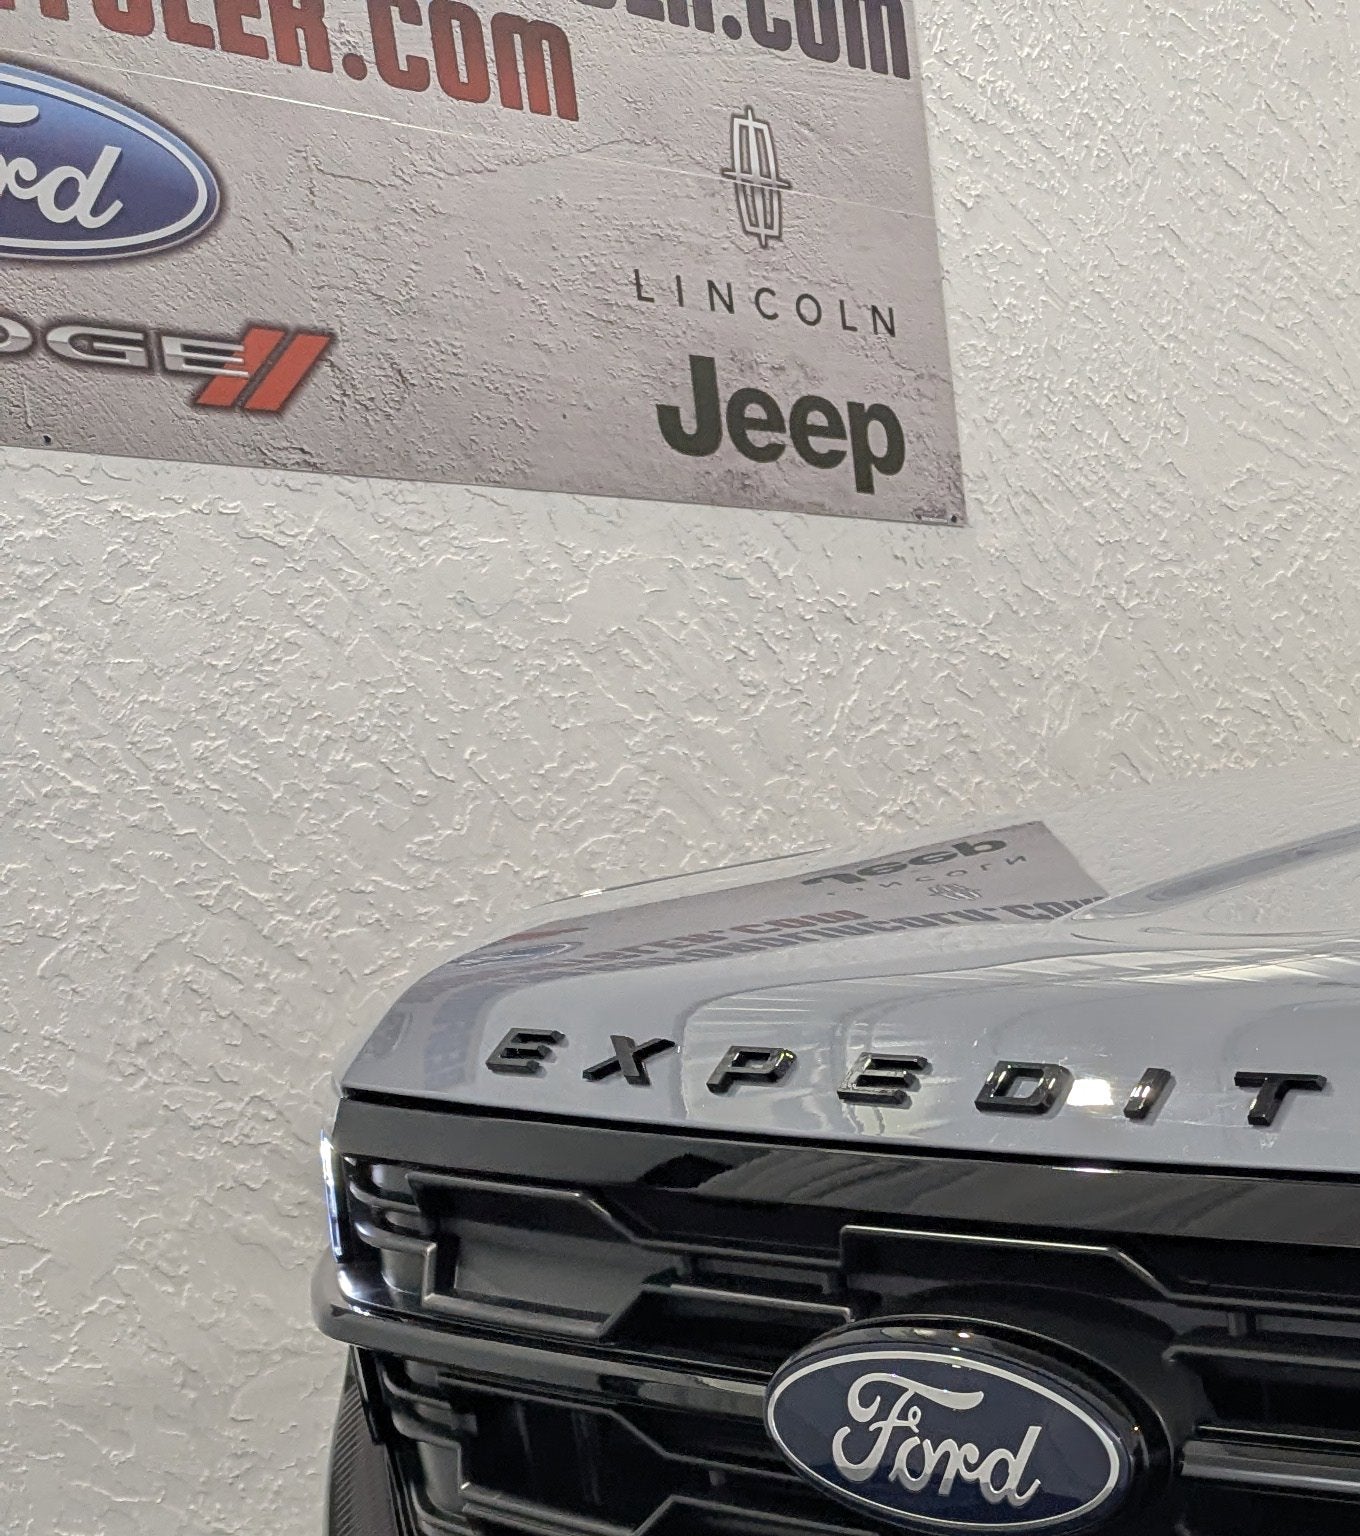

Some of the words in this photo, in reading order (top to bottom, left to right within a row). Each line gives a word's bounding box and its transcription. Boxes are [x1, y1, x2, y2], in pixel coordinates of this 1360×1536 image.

[0, 104, 124, 229] rd
[634, 268, 896, 338] LINCOLN
[656, 354, 906, 495] Jeep
[832, 1371, 1042, 1506] Ford
